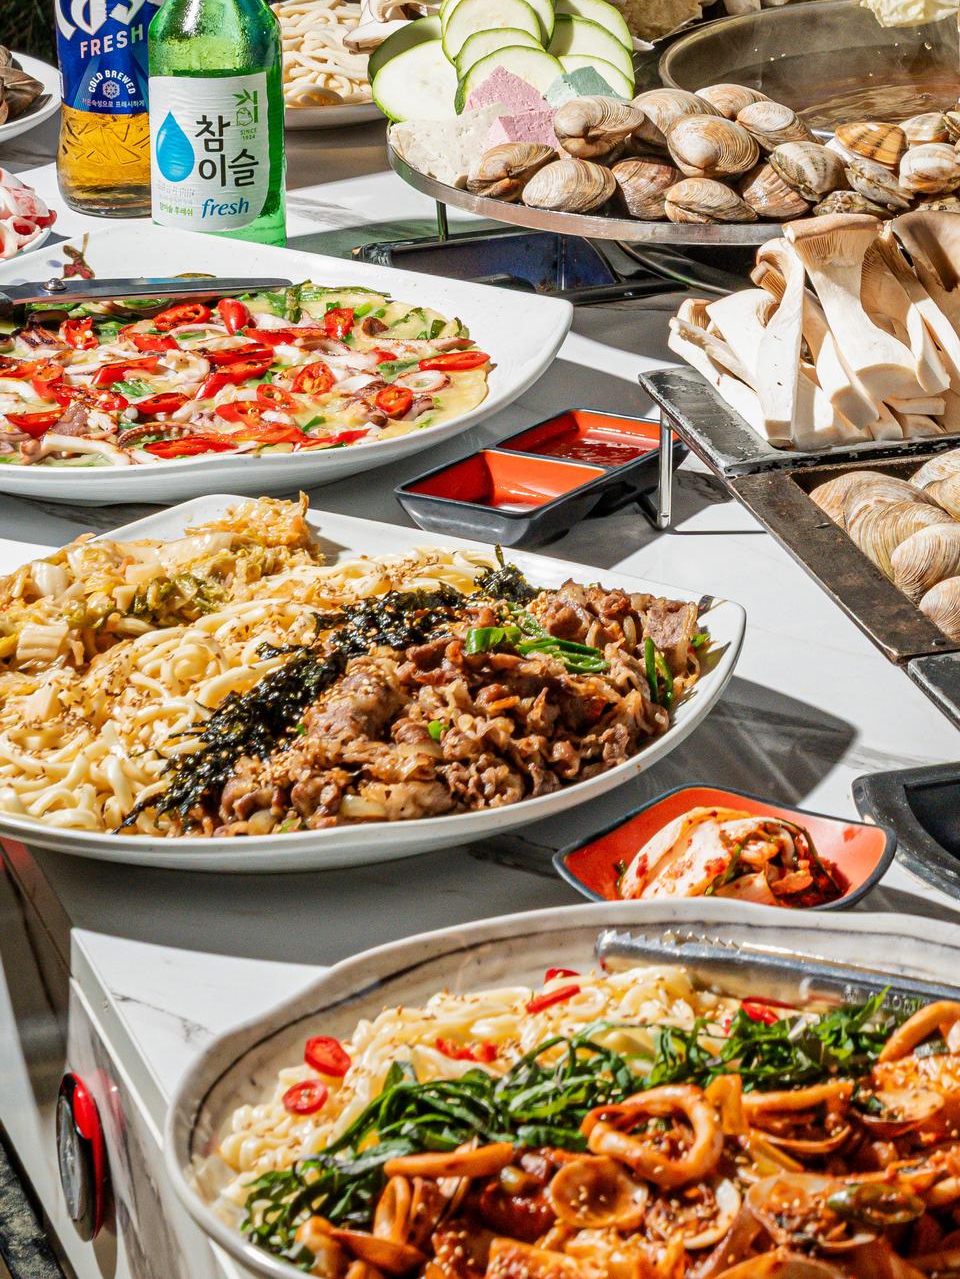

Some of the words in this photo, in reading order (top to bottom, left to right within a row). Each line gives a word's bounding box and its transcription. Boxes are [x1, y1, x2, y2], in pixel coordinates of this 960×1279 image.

[80, 24, 144, 59] FRESH
[88, 72, 104, 93] COLD
[104, 69, 136, 95] BREWED
[194, 115, 231, 153] 참
[198, 148, 260, 187] 이슬
[201, 197, 249, 219] fresh
